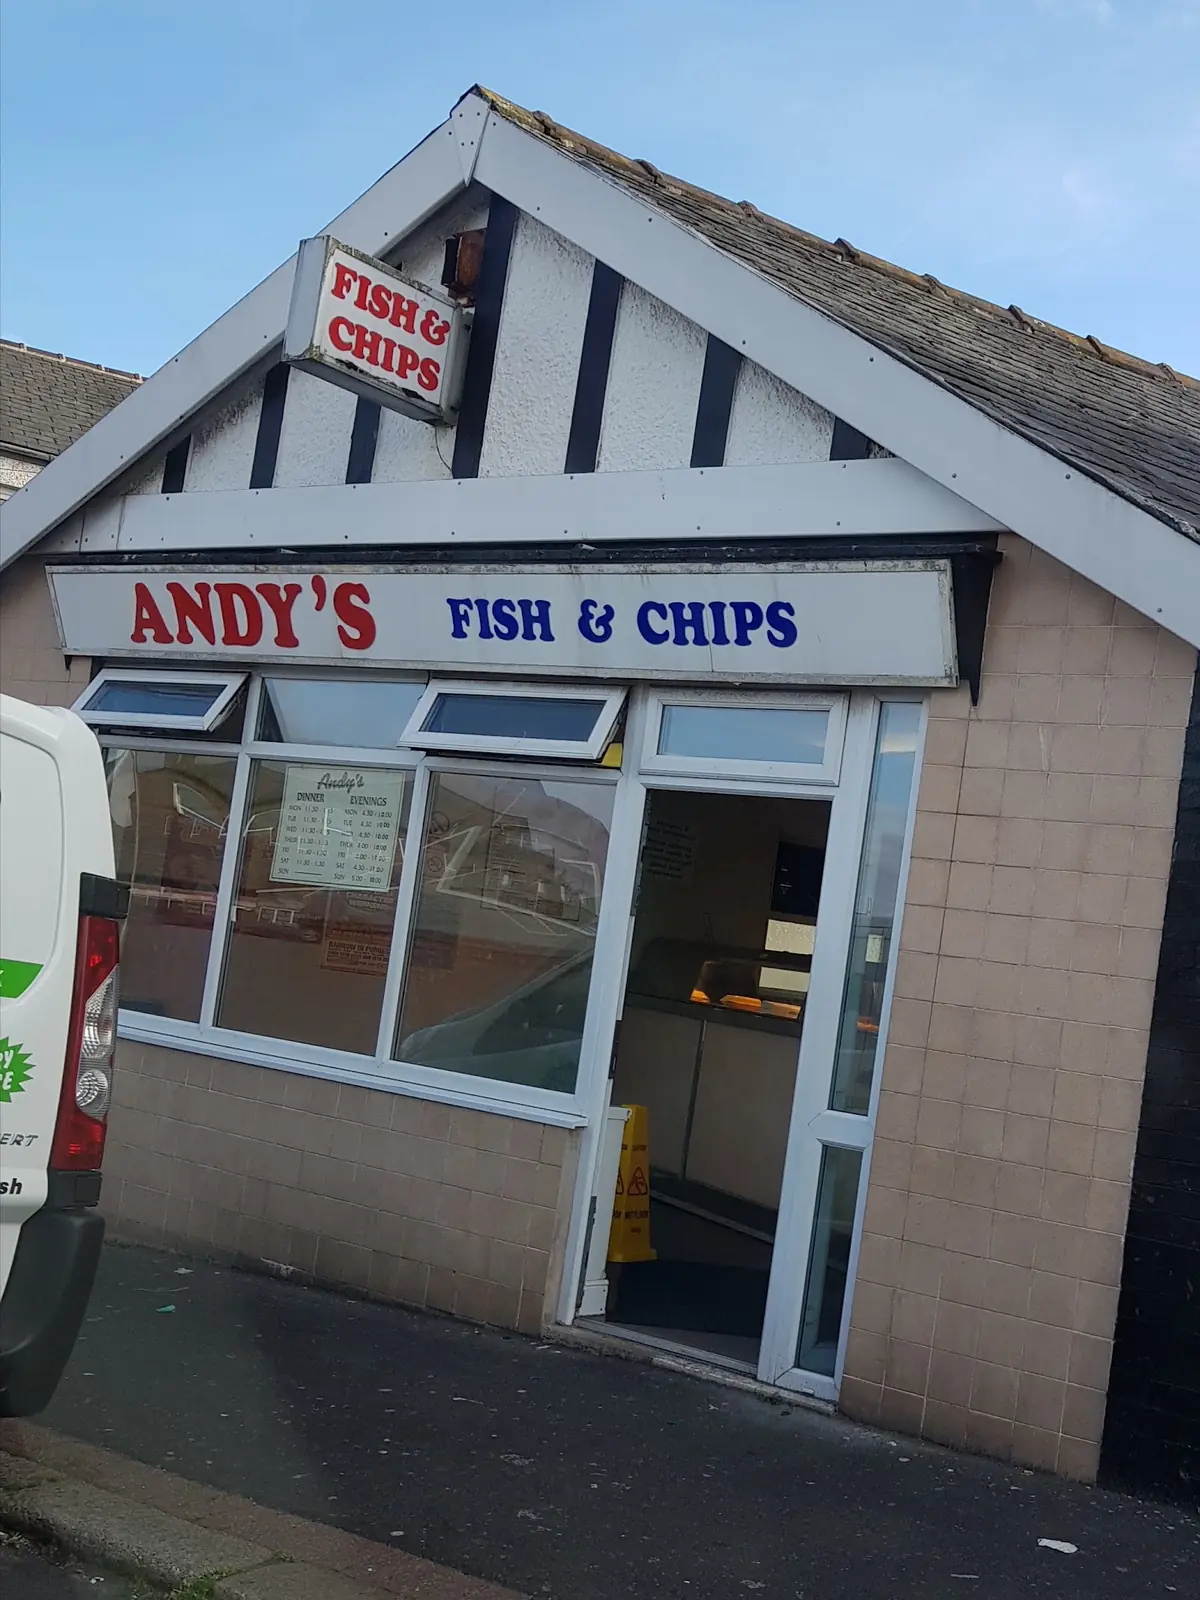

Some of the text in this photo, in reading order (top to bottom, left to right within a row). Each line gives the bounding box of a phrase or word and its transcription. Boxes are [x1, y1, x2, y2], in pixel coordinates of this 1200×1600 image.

[331, 262, 451, 346] FISH &
[328, 315, 440, 392] CHIPS
[130, 574, 377, 650] ANDY'S
[446, 597, 797, 648] FISH & CHIPS
[296, 792, 324, 802] DINNER
[317, 772, 365, 794] Andy's
[350, 796, 387, 806] EVENINGS
